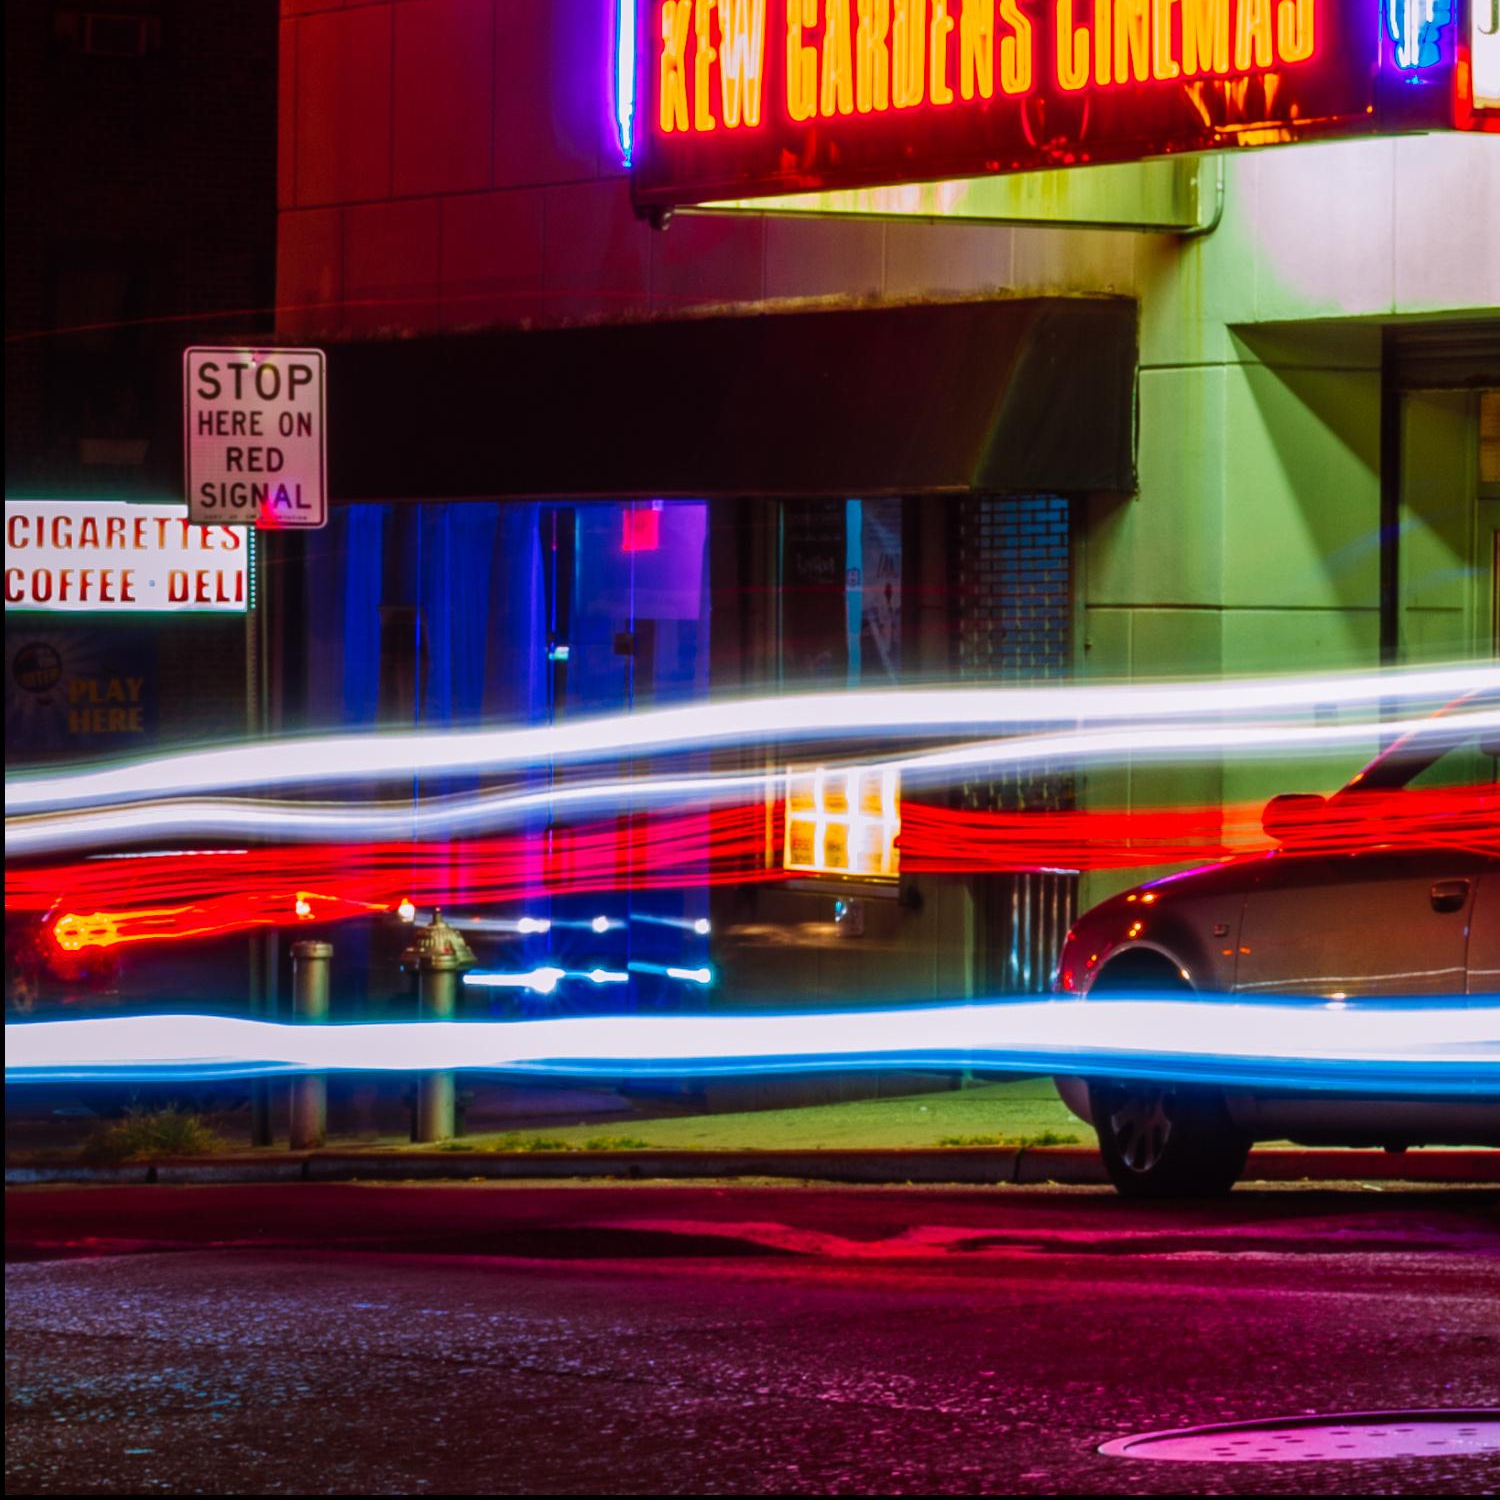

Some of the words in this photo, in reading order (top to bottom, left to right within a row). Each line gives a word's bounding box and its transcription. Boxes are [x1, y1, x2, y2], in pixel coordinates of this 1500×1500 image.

[197, 361, 313, 401] STOP
[199, 410, 263, 436] HERE
[279, 411, 312, 437] ON
[227, 446, 284, 473] RED
[200, 482, 312, 509] SIGNAL
[7, 515, 241, 550] CIGARETTES
[5, 567, 136, 603] COFFEE
[168, 569, 243, 603] DELI
[67, 676, 144, 703] PLAY
[67, 707, 144, 734] HERE
